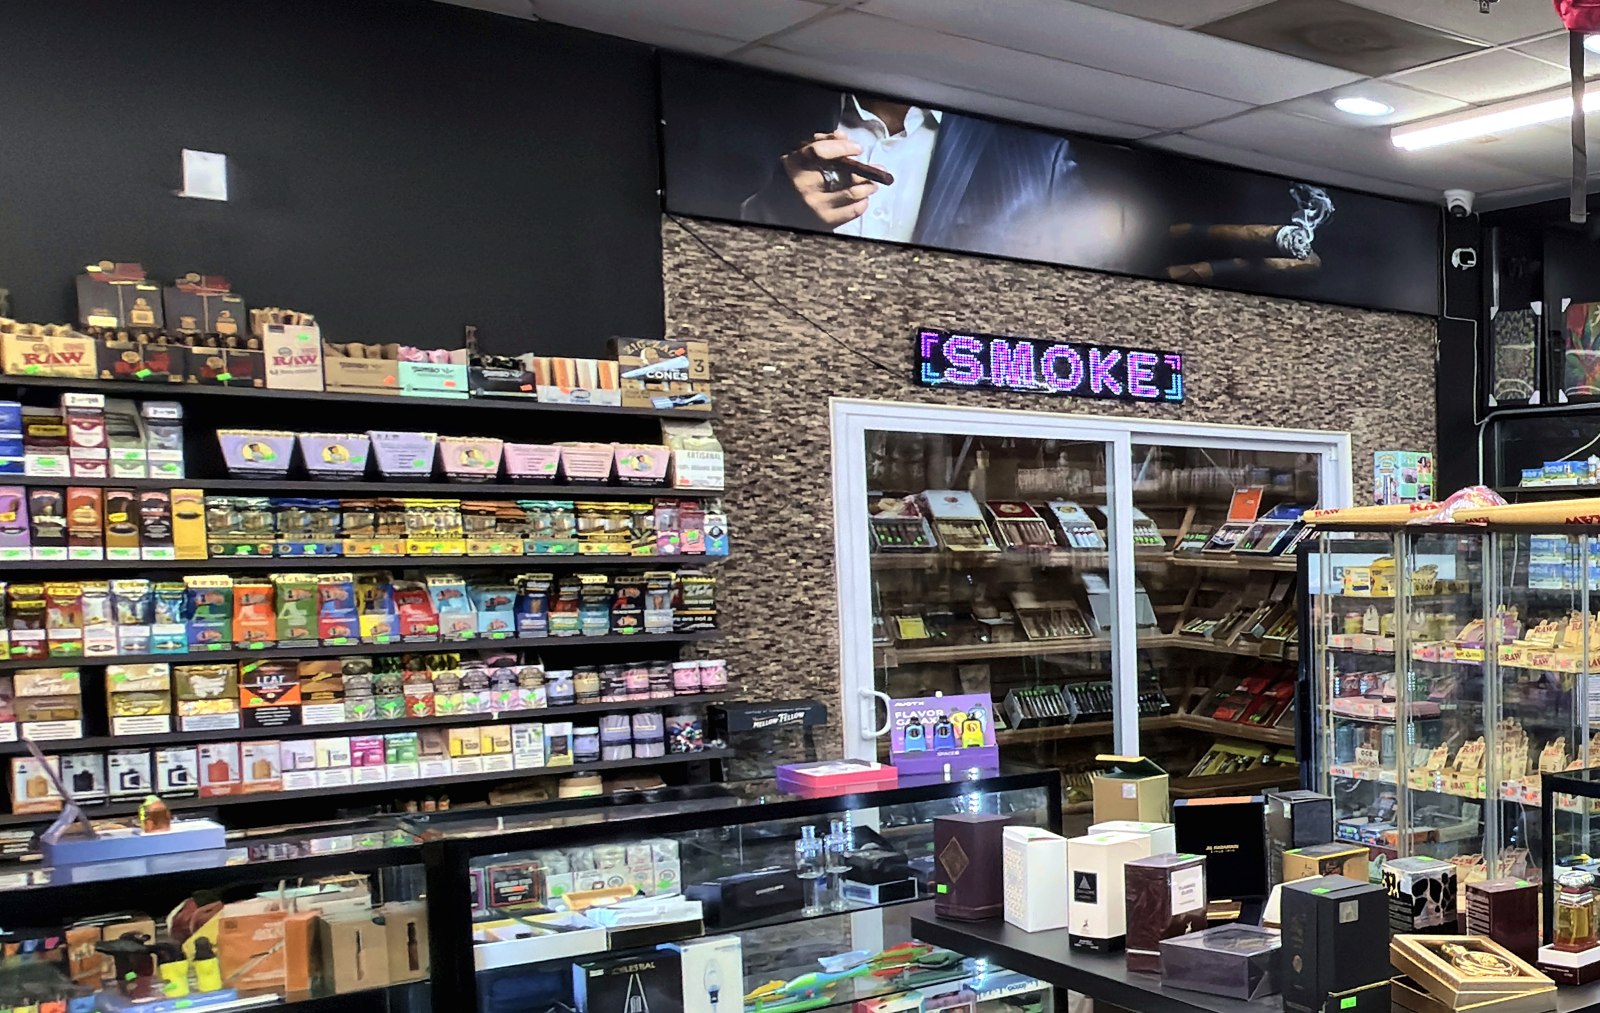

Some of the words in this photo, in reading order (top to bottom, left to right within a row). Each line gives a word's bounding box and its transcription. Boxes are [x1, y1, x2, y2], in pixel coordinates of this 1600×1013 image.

[23, 351, 84, 365] RAW
[272, 355, 317, 366] RAW
[693, 359, 704, 373] 3
[942, 334, 1160, 398] SMOKE
[646, 371, 688, 381] CONES
[1410, 501, 1443, 513] RA
[1315, 509, 1340, 518] RAW
[1535, 624, 1554, 634] RAW
[1504, 652, 1521, 661] RAW
[1533, 657, 1550, 667] RAW
[895, 709, 945, 719] FLAVOR
[753, 718, 779, 729] MELLOW
[778, 711, 805, 723] FELLOW
[1463, 743, 1485, 753] RAW
